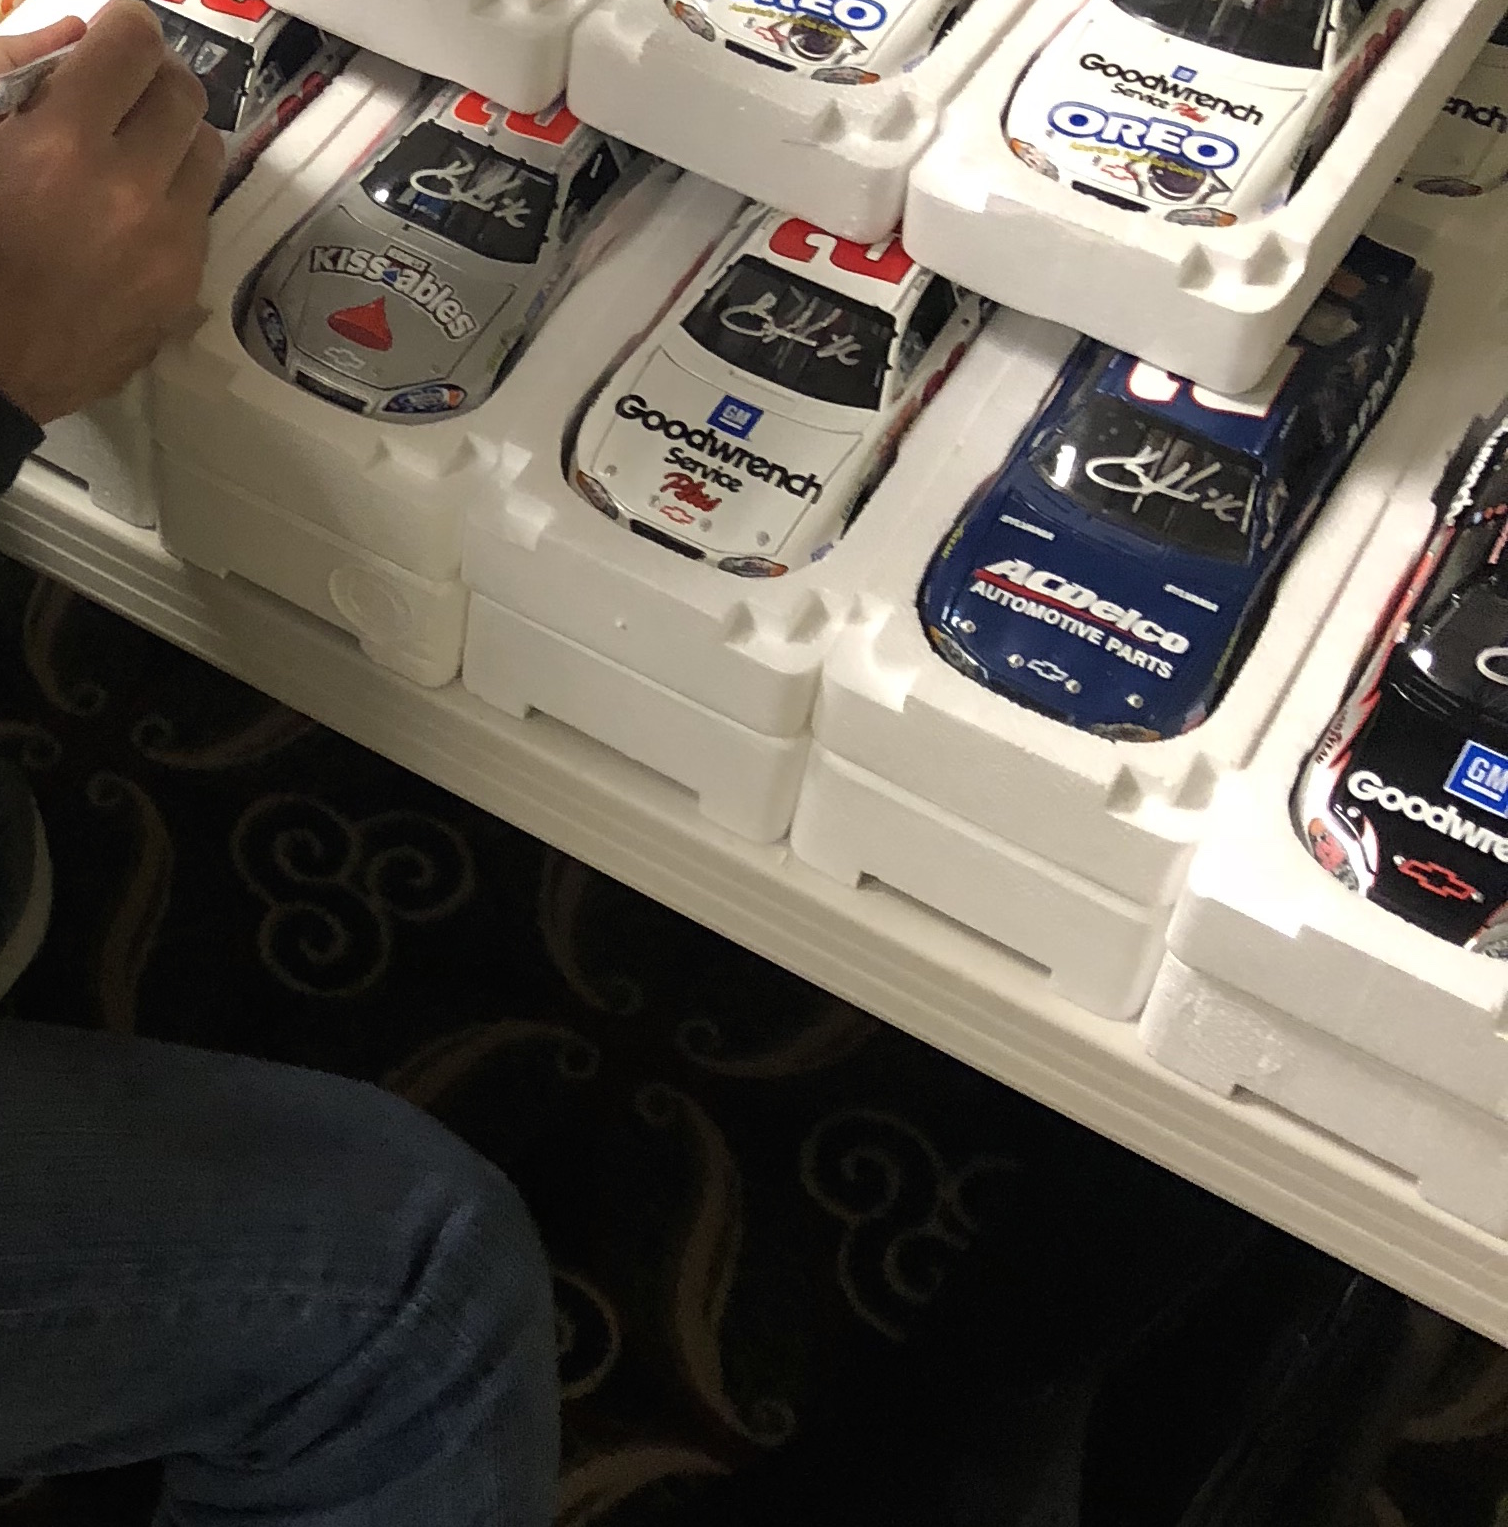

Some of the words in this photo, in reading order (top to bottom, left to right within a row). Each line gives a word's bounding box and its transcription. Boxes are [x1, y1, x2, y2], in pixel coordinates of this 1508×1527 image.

[1079, 53, 1264, 126] Goodwrench
[1111, 81, 1171, 110] Service
[1170, 102, 1210, 124] Plus
[1047, 100, 1239, 170] OREO
[615, 394, 823, 504] Goodwrench
[664, 447, 744, 493] Service
[660, 472, 722, 512] Plus
[970, 580, 1105, 646] AUTOMOTIVE
[1105, 635, 1174, 680] PARTS
[984, 558, 1190, 654] ACDelco
